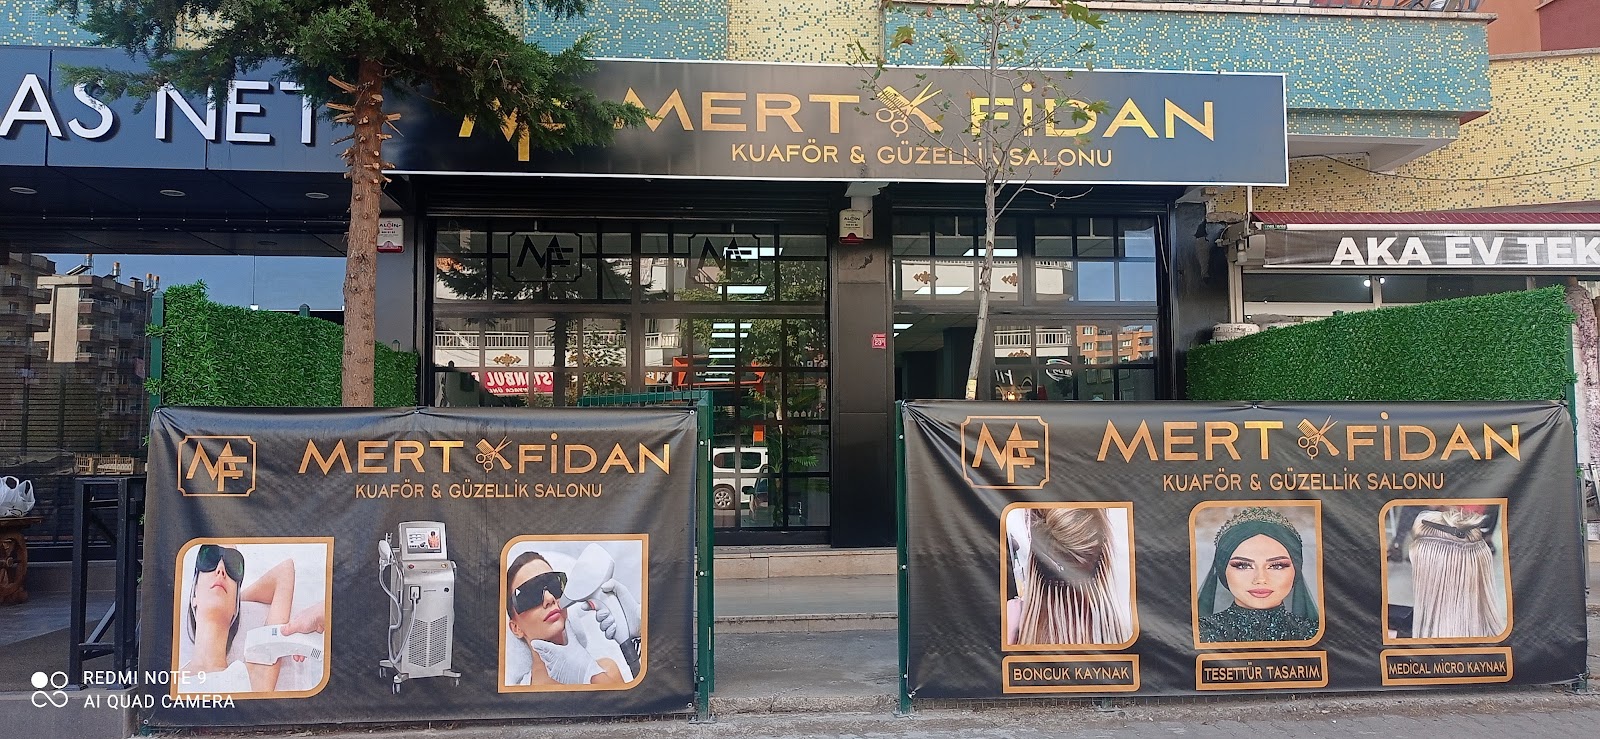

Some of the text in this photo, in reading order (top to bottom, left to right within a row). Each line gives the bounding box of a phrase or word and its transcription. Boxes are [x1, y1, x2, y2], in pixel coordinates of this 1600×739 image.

[0, 73, 318, 145] AS NET
[614, 87, 860, 134] MERT
[969, 82, 1215, 142] FİDAN
[731, 138, 839, 164] KUAFÖR
[849, 145, 866, 164] &
[1009, 148, 1113, 168] SALONU
[1330, 236, 1600, 266] AKA EV TEK
[1097, 411, 1521, 464] MERT FİDAN
[298, 433, 671, 475] MERT FİDAN
[355, 479, 603, 499] KUAFÖR & GÜZELLİK SALONU
[1163, 467, 1445, 492] KUAFÖR & GÜZELLİK SALONU
[1013, 666, 1130, 681] BONCUK KAYNAK
[1204, 662, 1320, 681] TESETTÜR TASARIM
[1388, 658, 1507, 675] MEDİCAL MİCRO KAYNAK
